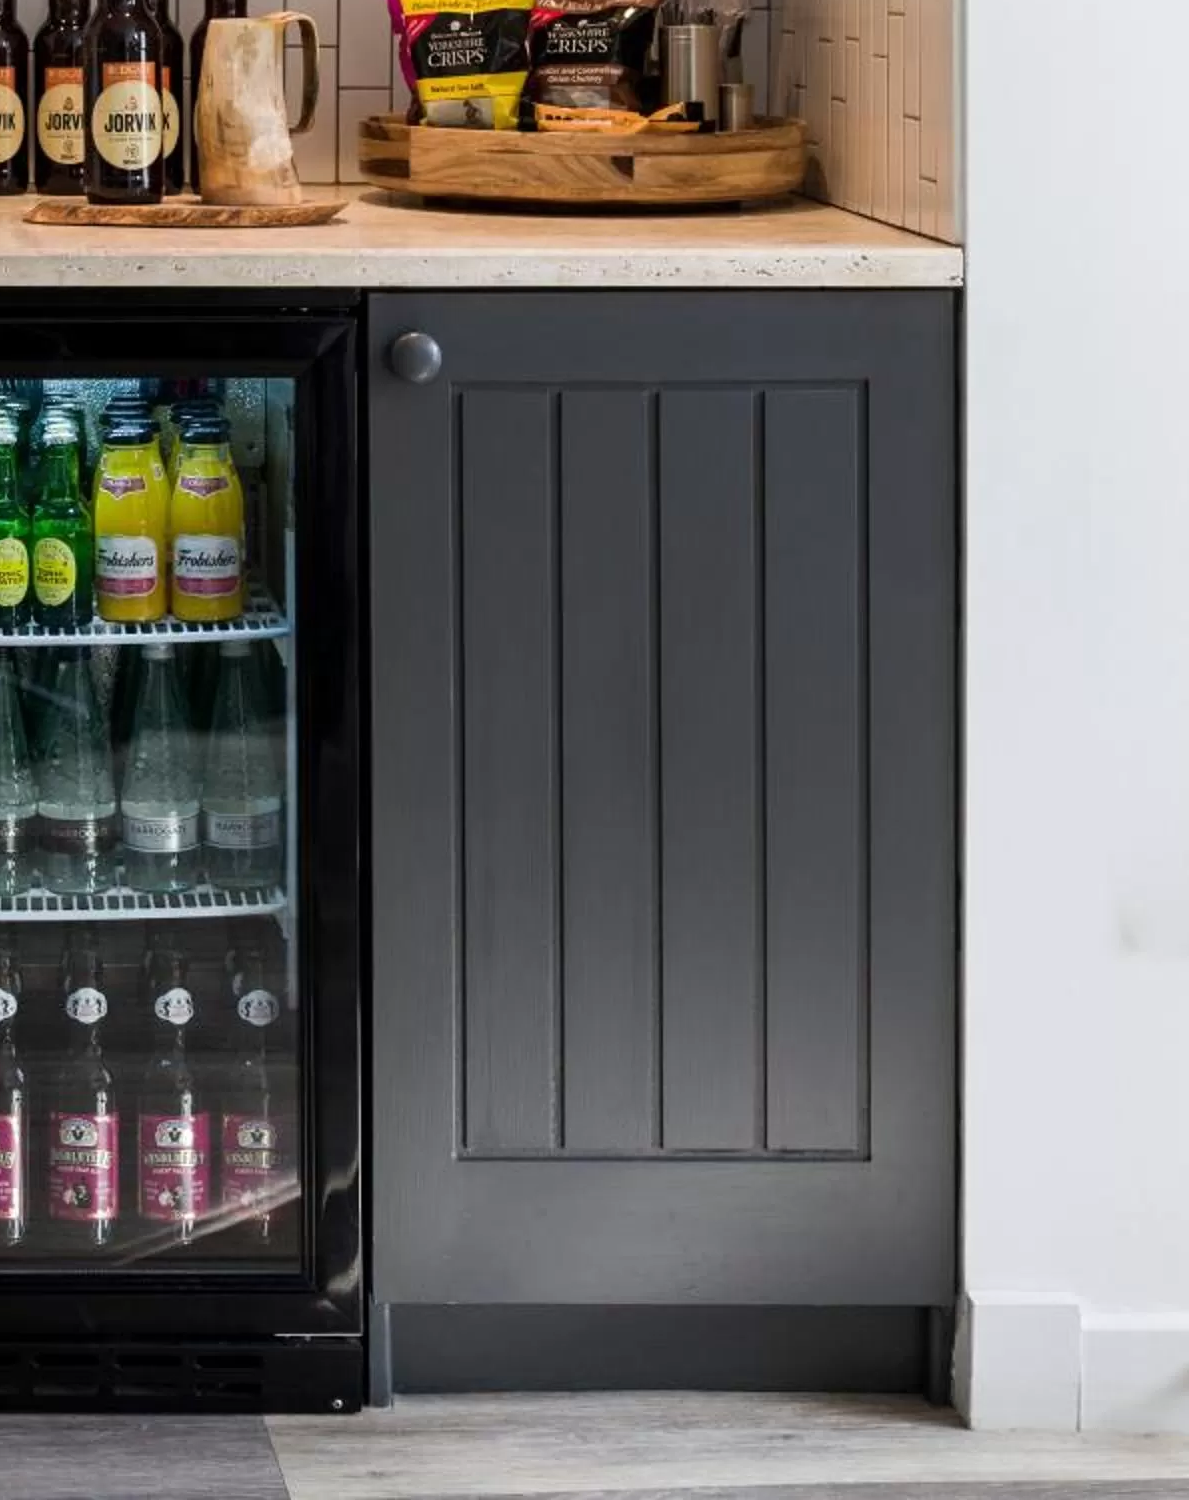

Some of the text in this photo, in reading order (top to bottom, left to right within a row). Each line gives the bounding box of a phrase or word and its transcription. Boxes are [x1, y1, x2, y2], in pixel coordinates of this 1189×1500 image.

[547, 39, 608, 53] CRISPS
[428, 47, 485, 68] CRISPS
[45, 112, 84, 131] JORV
[104, 112, 157, 133] JORVIK
